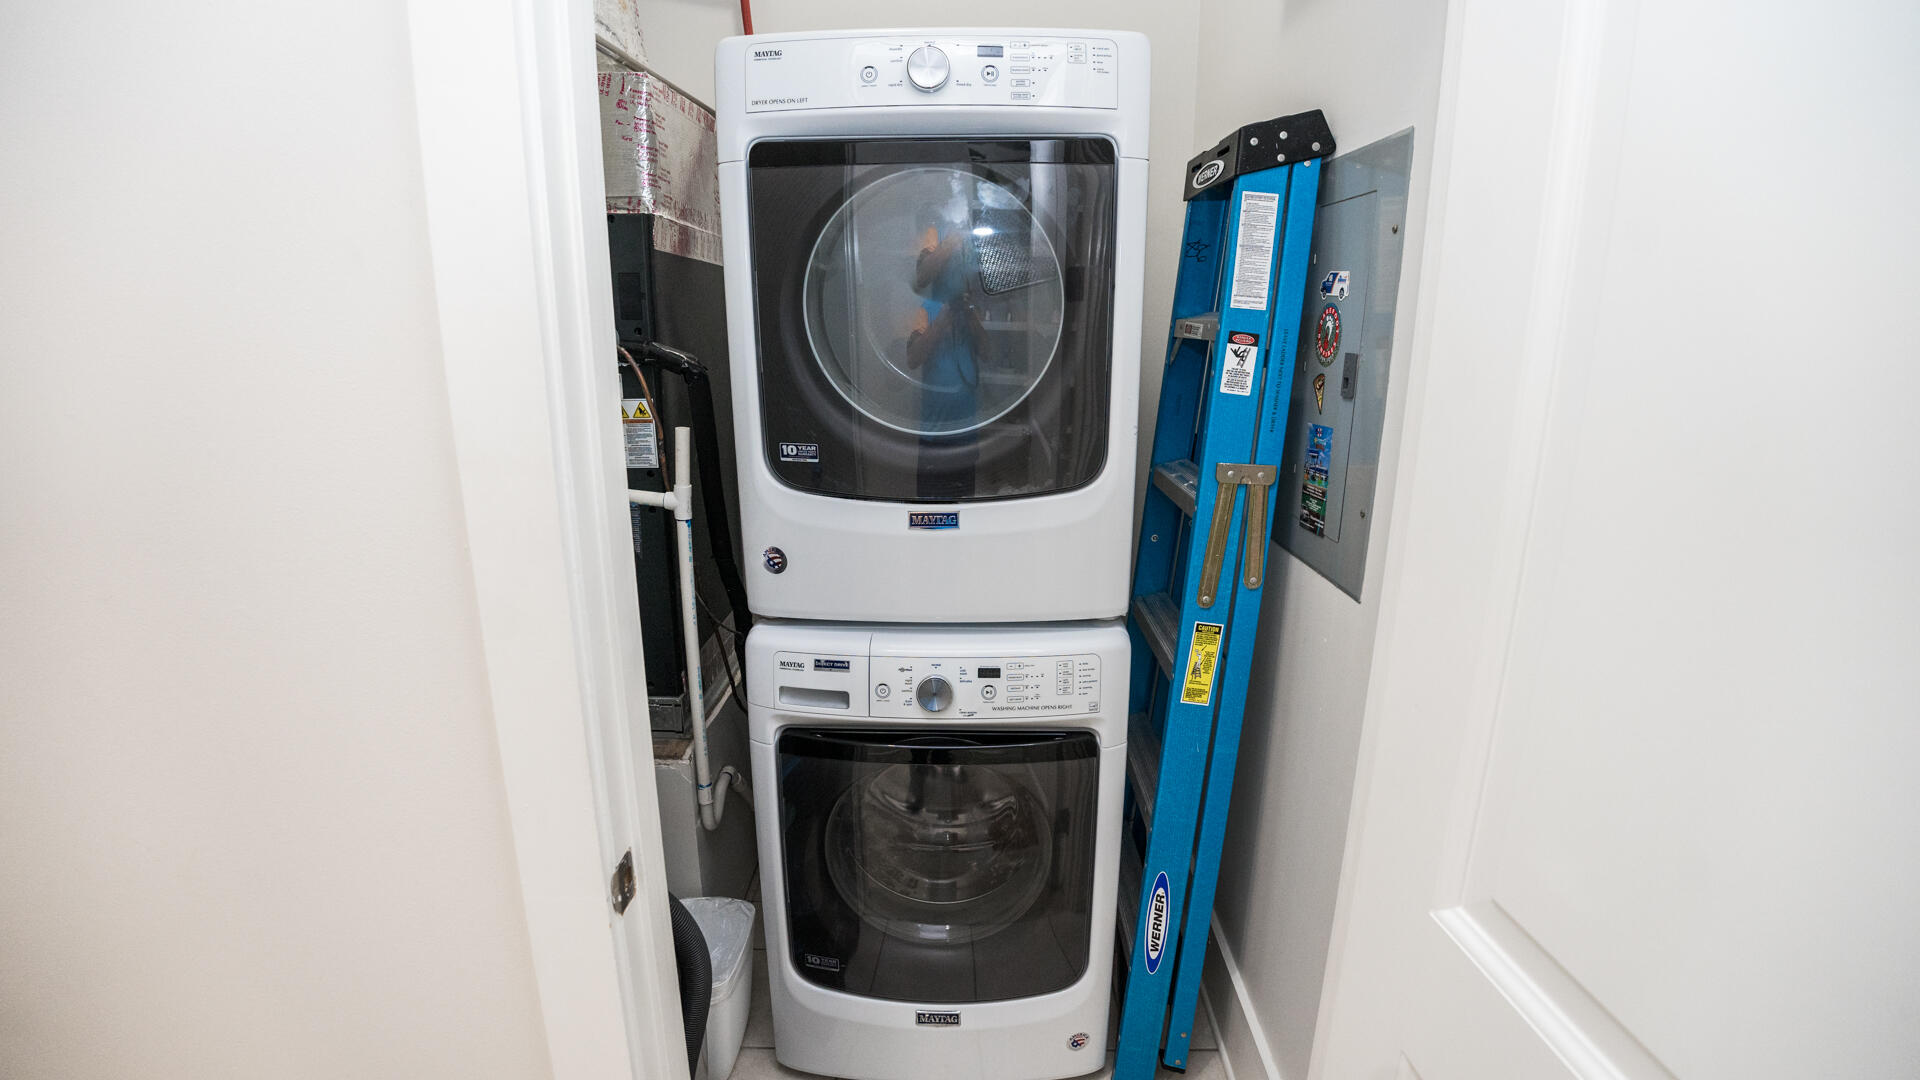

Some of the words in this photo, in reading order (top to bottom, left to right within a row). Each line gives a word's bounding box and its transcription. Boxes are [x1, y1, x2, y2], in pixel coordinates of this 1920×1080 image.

[753, 50, 783, 58] MAYTAG
[1197, 164, 1219, 184] WERNER
[781, 444, 797, 456] 10
[911, 515, 957, 525] MAYTAG
[779, 660, 805, 668] MAYTAG
[1150, 893, 1165, 952] WERNER
[919, 1014, 958, 1023] MAYTAG
